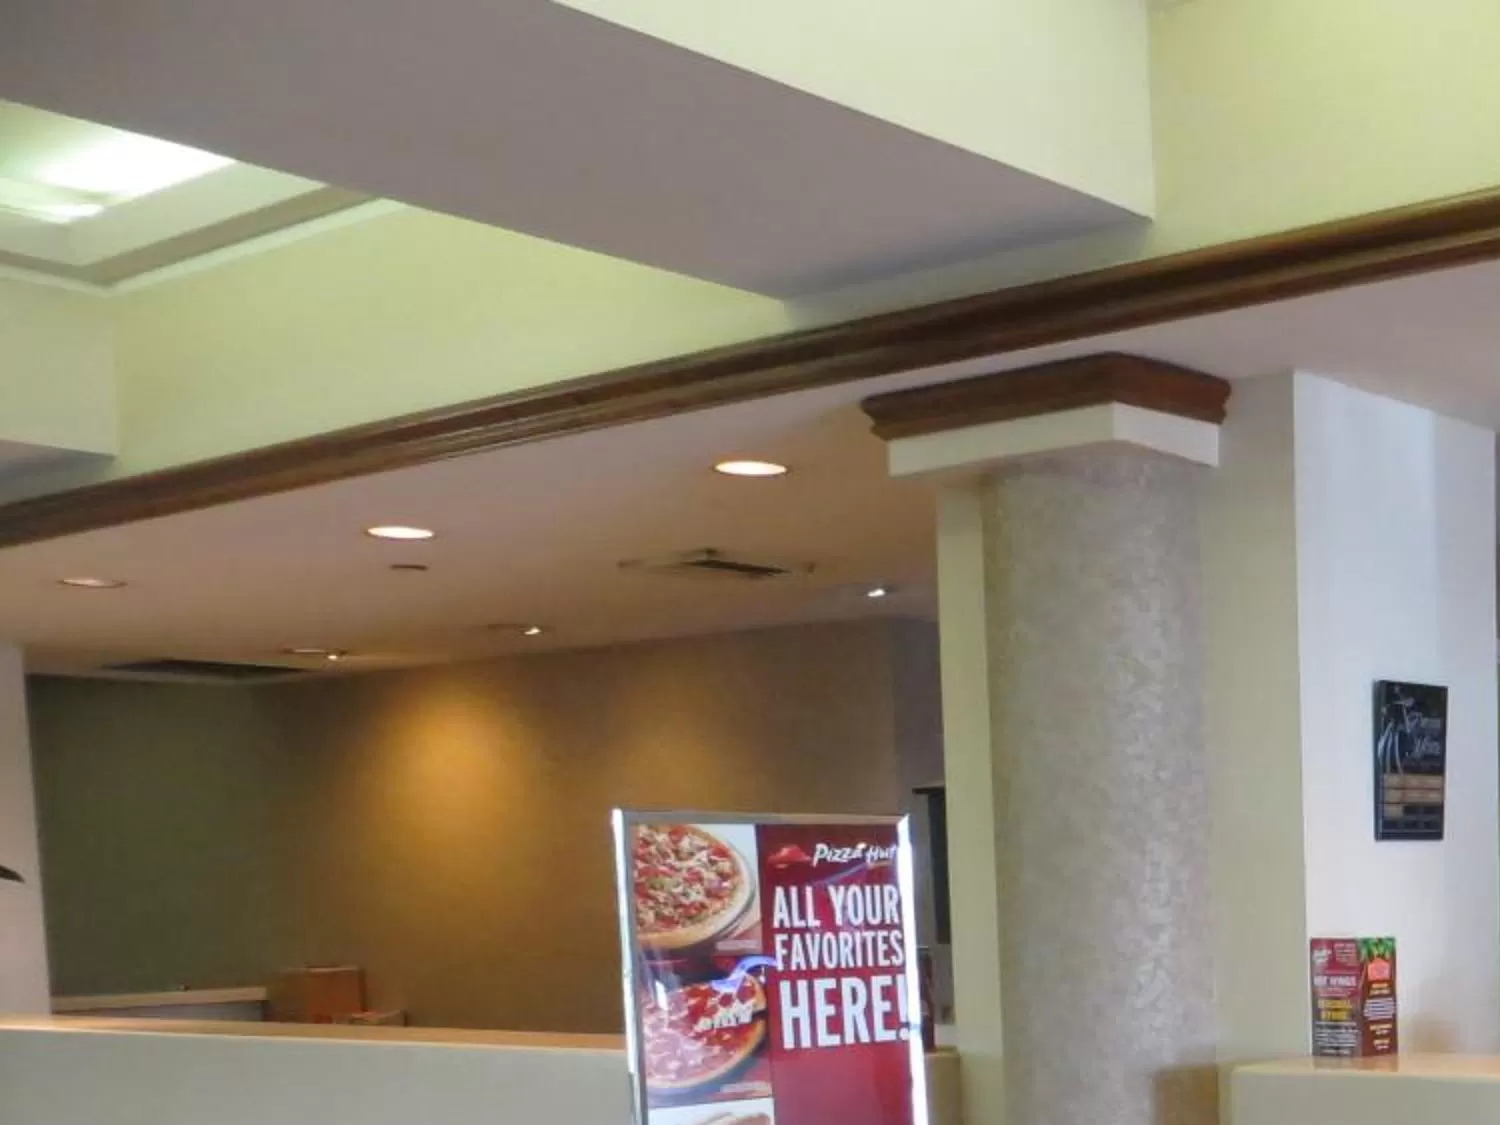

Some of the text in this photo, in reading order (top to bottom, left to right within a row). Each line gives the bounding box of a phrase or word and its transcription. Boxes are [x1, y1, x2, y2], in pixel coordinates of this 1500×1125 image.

[812, 842, 866, 868] Pizza
[773, 883, 900, 929] ALL YOUR
[774, 929, 904, 972] FAVORITES
[779, 974, 910, 1050] HERE!
